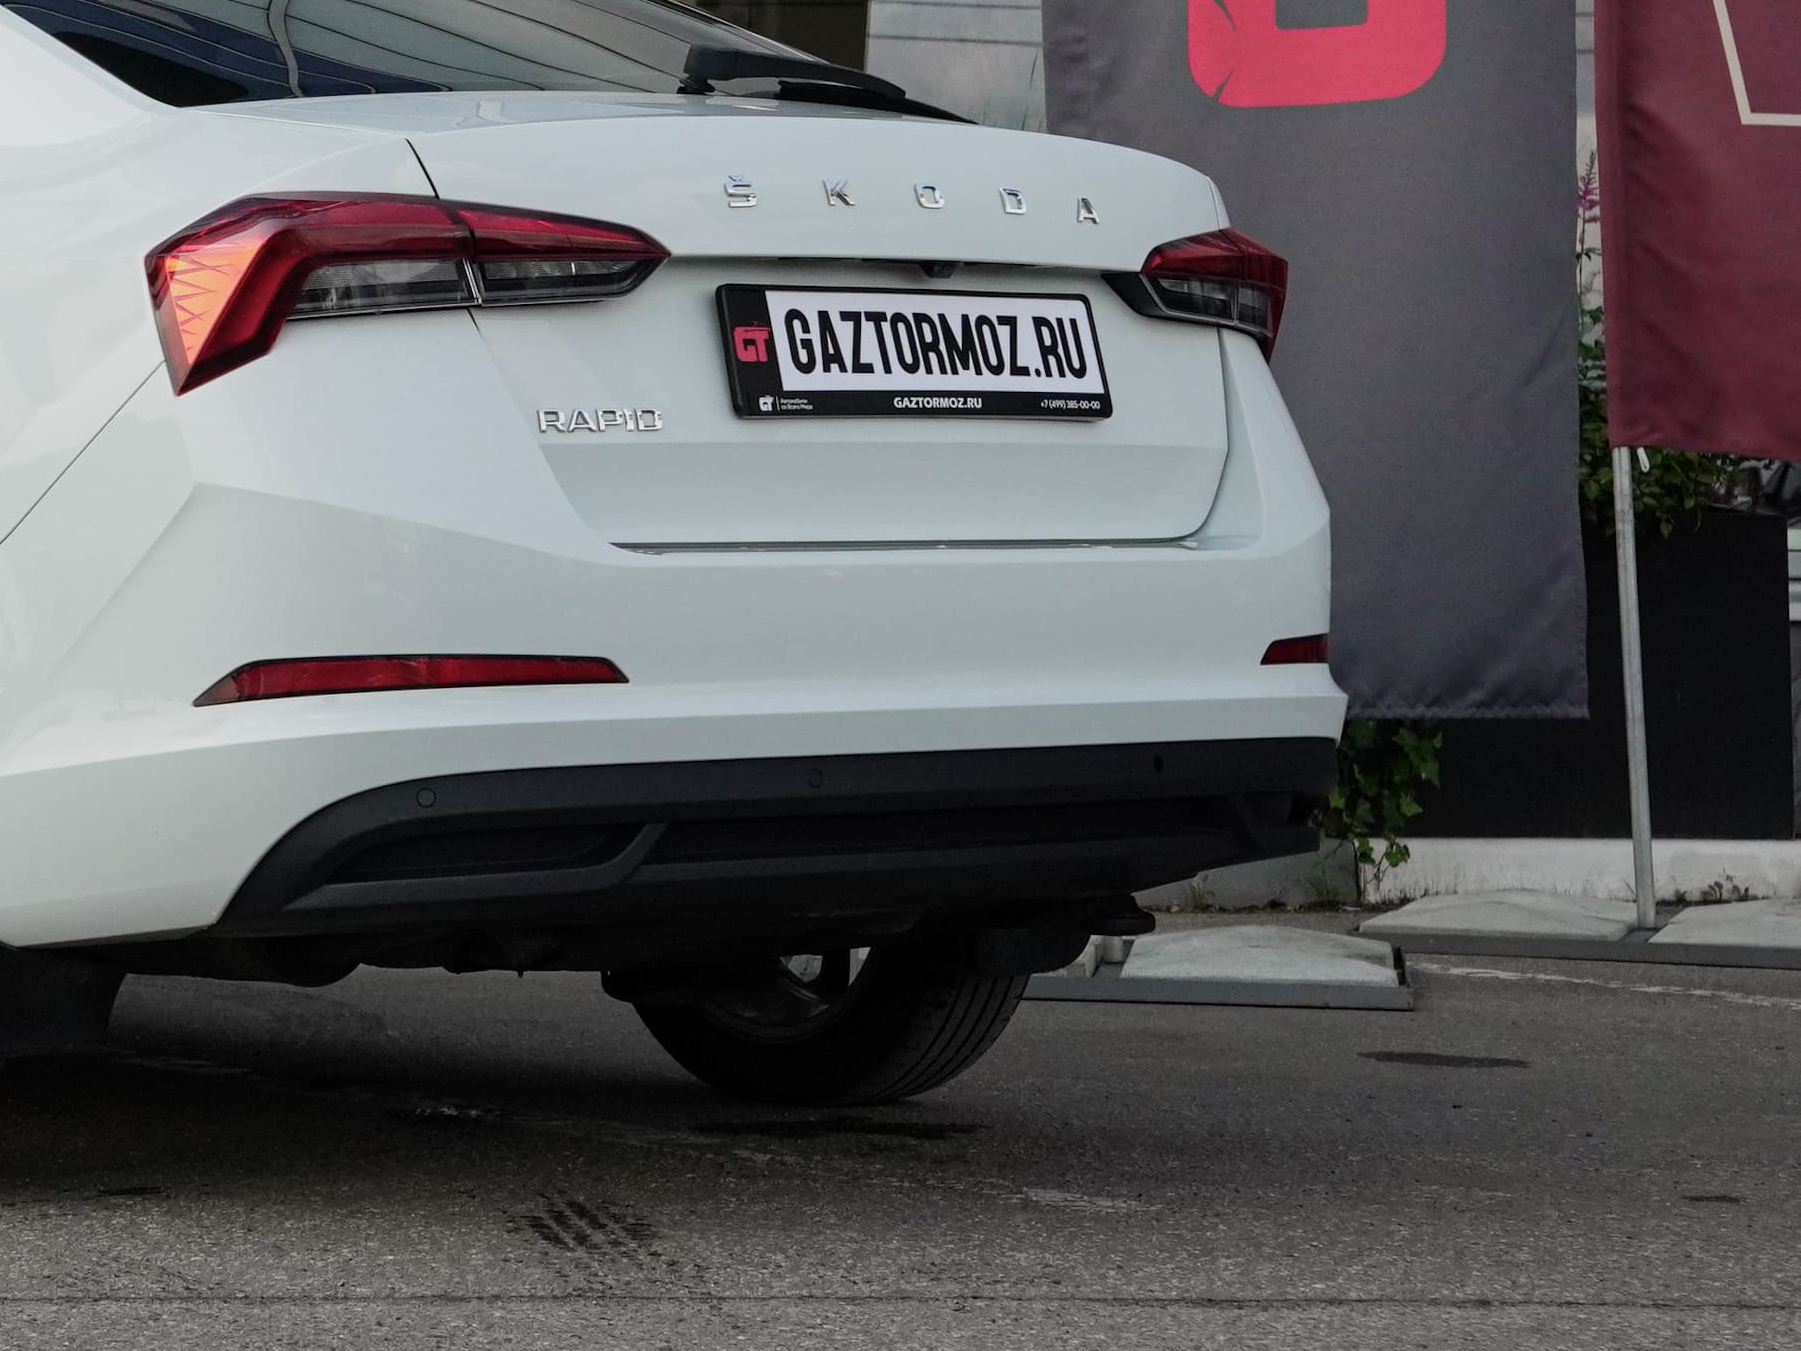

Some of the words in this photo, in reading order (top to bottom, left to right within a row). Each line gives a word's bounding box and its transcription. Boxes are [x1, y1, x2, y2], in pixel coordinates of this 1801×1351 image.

[784, 308, 1087, 379] GAZTORMOZ.RU
[893, 396, 983, 410] GAZTORMOZ.RU
[537, 408, 663, 433] RAPID
